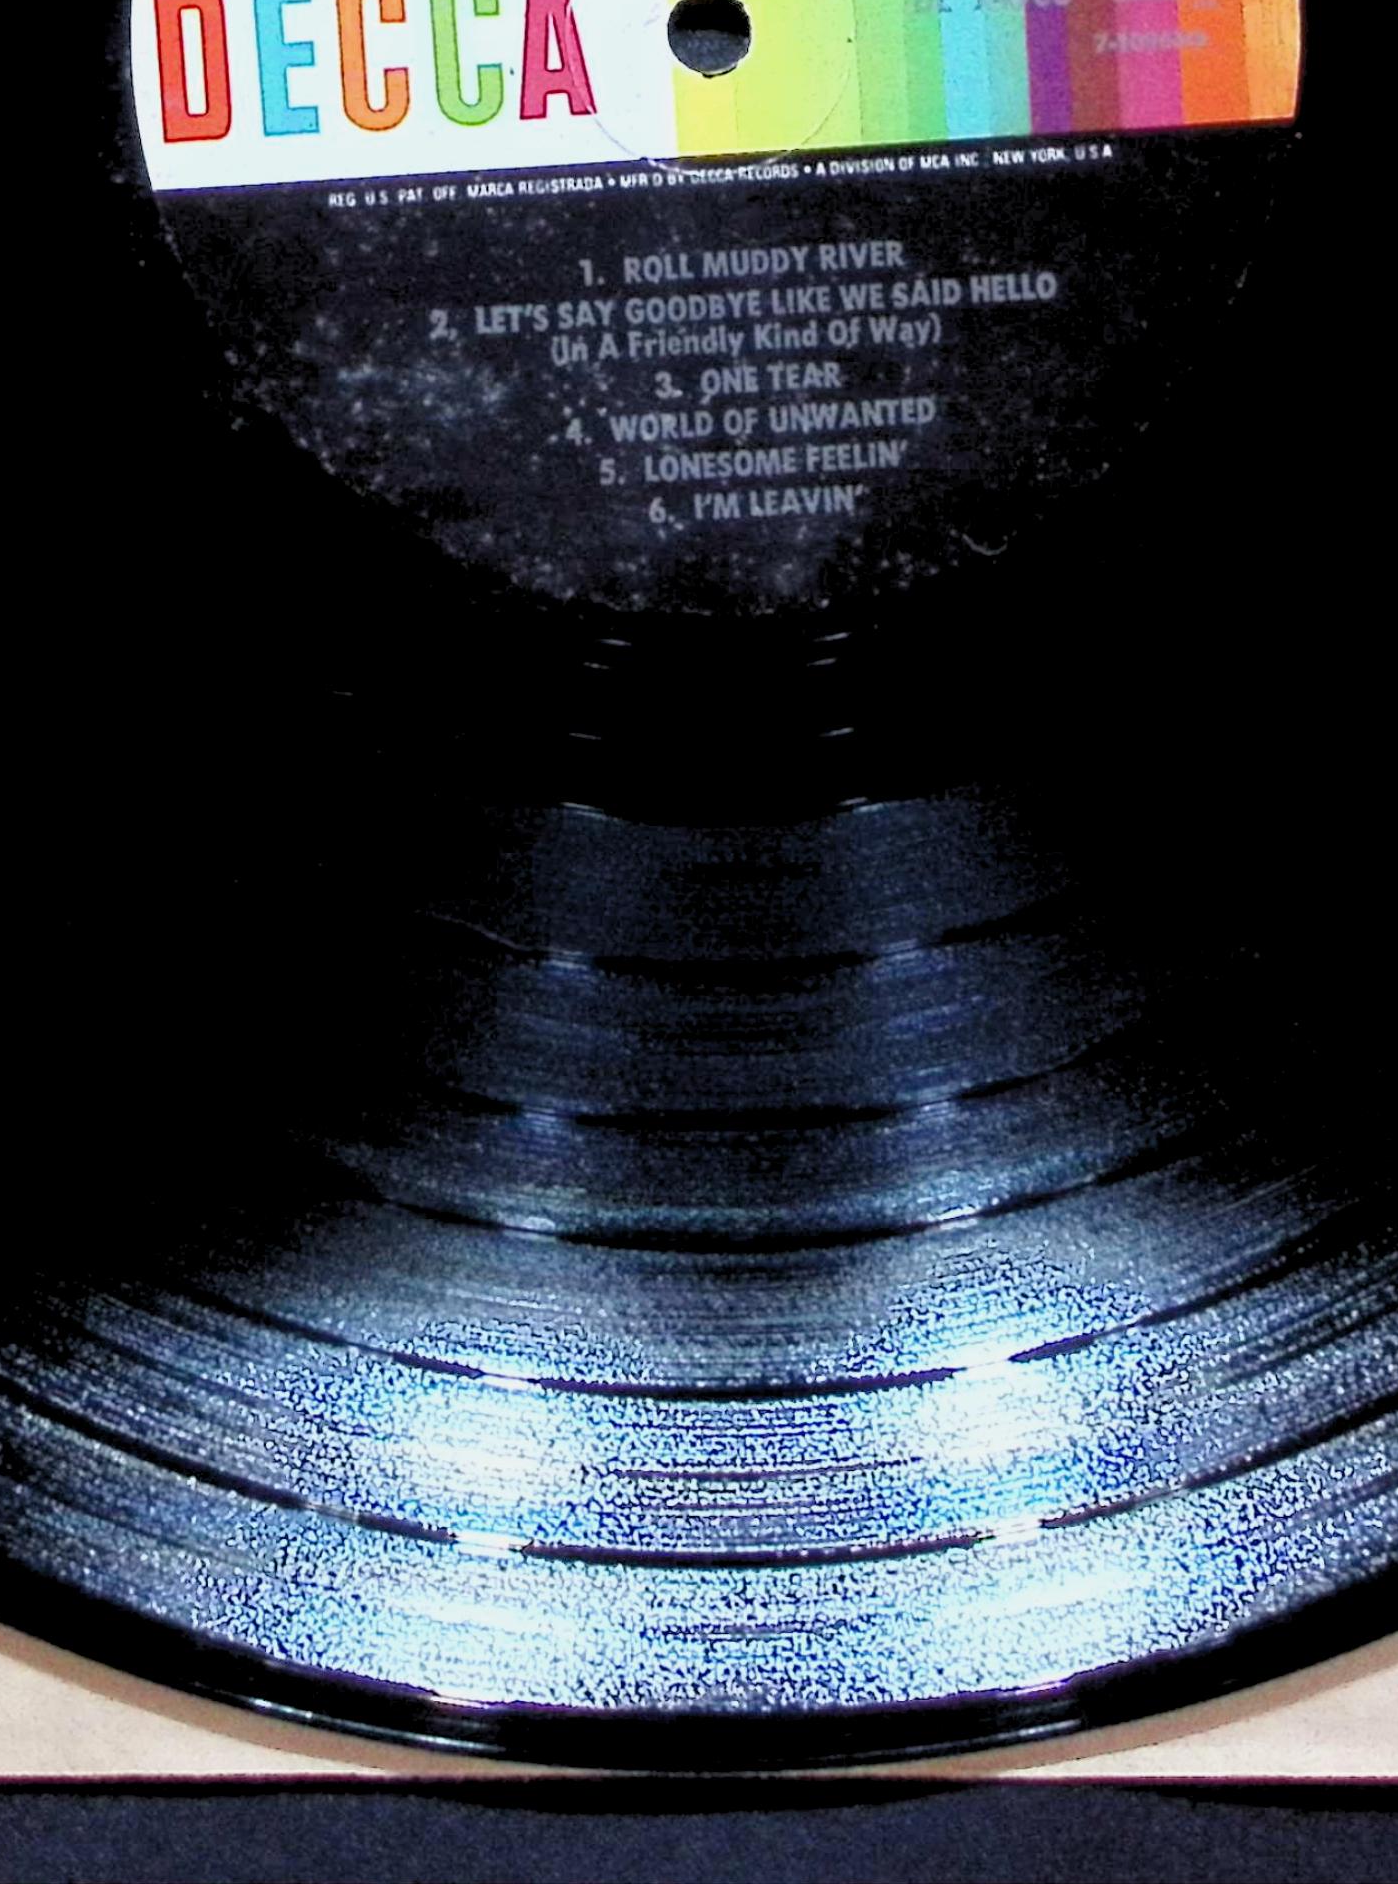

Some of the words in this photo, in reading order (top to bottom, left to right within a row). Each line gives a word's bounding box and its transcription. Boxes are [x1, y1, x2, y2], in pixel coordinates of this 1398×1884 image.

[467, 181, 514, 198] MARCA
[518, 177, 603, 197] REGISTRADA
[737, 163, 799, 183] RECORDS
[815, 160, 827, 177] A
[829, 157, 895, 177] DIVISION
[899, 154, 917, 172] OF
[920, 153, 950, 170] MCA
[993, 149, 1024, 166] NEW
[579, 259, 605, 286] 1.
[623, 254, 694, 283] ROLL
[702, 245, 809, 278] MUDDY
[819, 240, 905, 271] RIVER
[474, 303, 549, 334] LET'S
[557, 299, 613, 330] SAY
[624, 290, 762, 325] GOODBYE
[771, 286, 831, 314] LIKE
[839, 283, 885, 311] WE
[891, 277, 961, 309] SAID
[969, 271, 1058, 304] HELLO
[598, 333, 619, 360] A
[627, 325, 744, 358] Friendly
[754, 320, 818, 350] Kind
[827, 318, 861, 348] Of
[868, 312, 942, 347] Way)
[655, 371, 684, 399] 3.
[701, 366, 758, 397] ONE
[767, 361, 843, 390] TEAR
[610, 411, 713, 443] WORLD
[723, 407, 758, 437] OF
[768, 396, 937, 434] UNWANTED
[599, 458, 626, 485] 5.
[644, 447, 796, 482] LONESOME
[806, 439, 907, 472] FEELIN'
[649, 496, 675, 523] 6.
[694, 492, 741, 521] I'M
[750, 484, 865, 517] LEAVIN'
